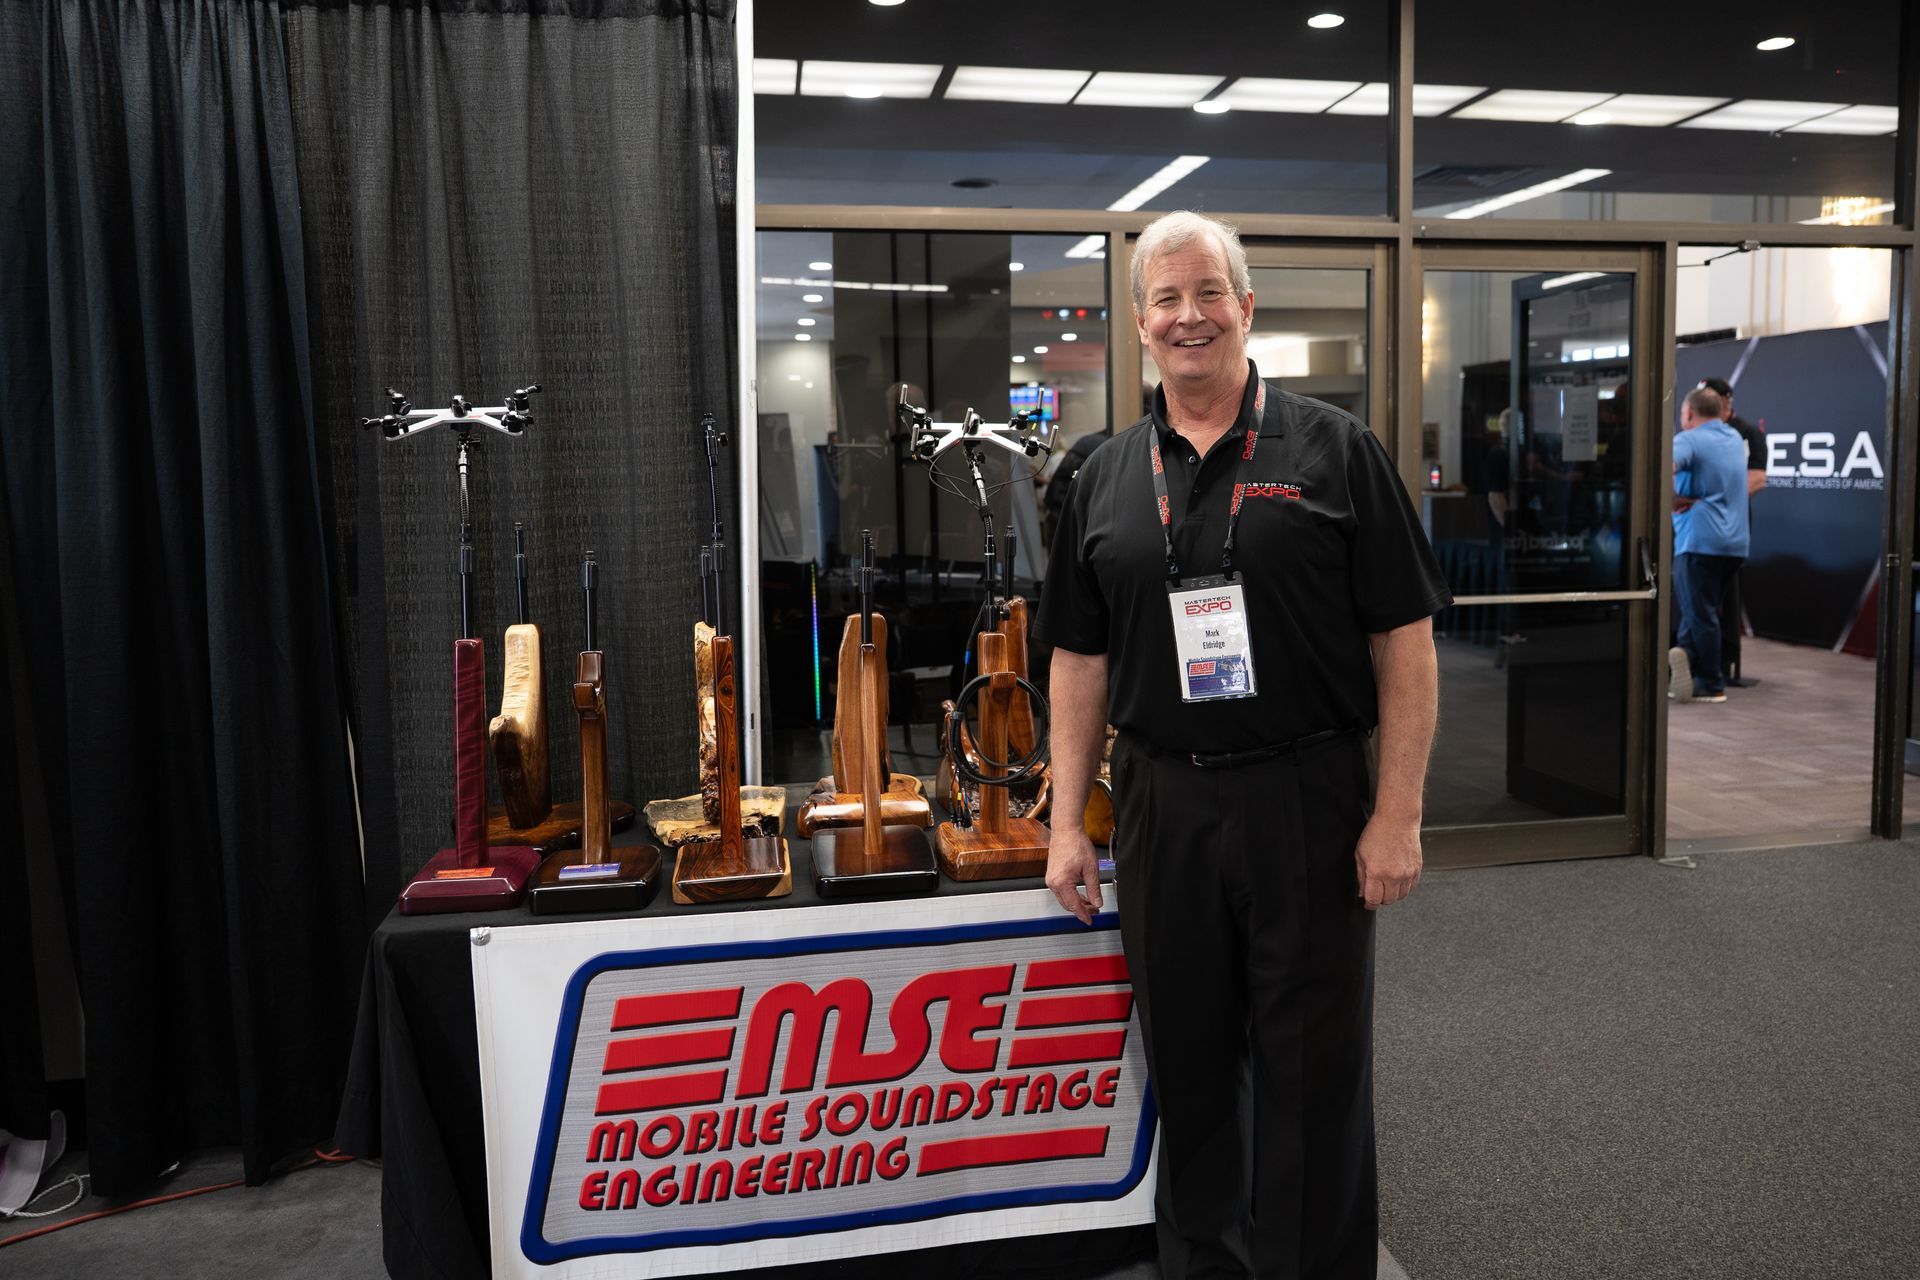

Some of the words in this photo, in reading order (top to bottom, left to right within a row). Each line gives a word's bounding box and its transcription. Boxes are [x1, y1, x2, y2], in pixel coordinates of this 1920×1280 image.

[1244, 482, 1302, 492] ASTERTECH
[1797, 477, 1841, 490] SPECIALISTS
[1842, 478, 1853, 490] OF
[1245, 487, 1300, 500] EXPO
[1184, 596, 1231, 605] MASTERTECH
[1185, 601, 1232, 615] EXPO
[1205, 629, 1220, 638] Mark
[1202, 640, 1226, 650] Eldridge
[735, 963, 1017, 1100] MSE
[586, 1100, 788, 1163] MOBILE
[799, 1067, 1121, 1142] SOUNDSTAGE
[579, 1136, 910, 1211] ENGINEERING
